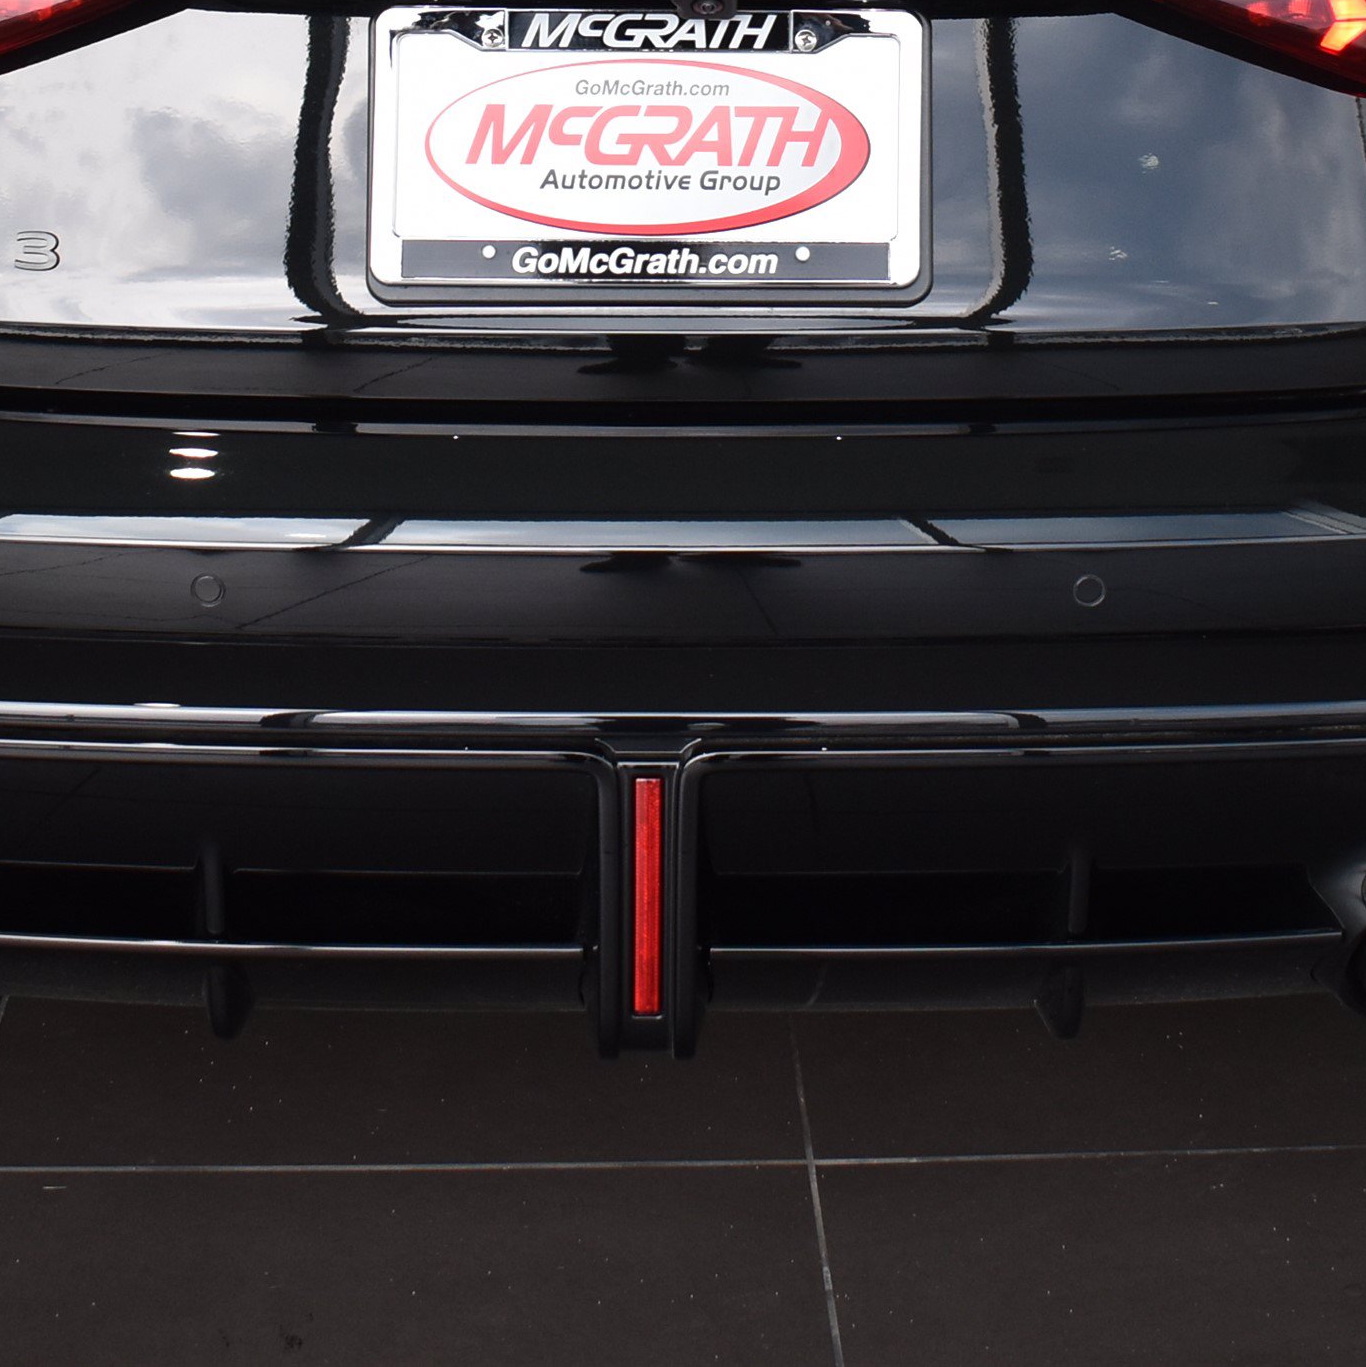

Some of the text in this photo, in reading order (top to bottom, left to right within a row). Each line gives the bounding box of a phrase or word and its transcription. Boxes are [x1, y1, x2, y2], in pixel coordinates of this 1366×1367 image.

[575, 79, 730, 97] GoMcGrath.com
[539, 169, 782, 196] Automotive Group
[14, 230, 61, 272] 3
[511, 246, 779, 275] GoMcGrath.com
